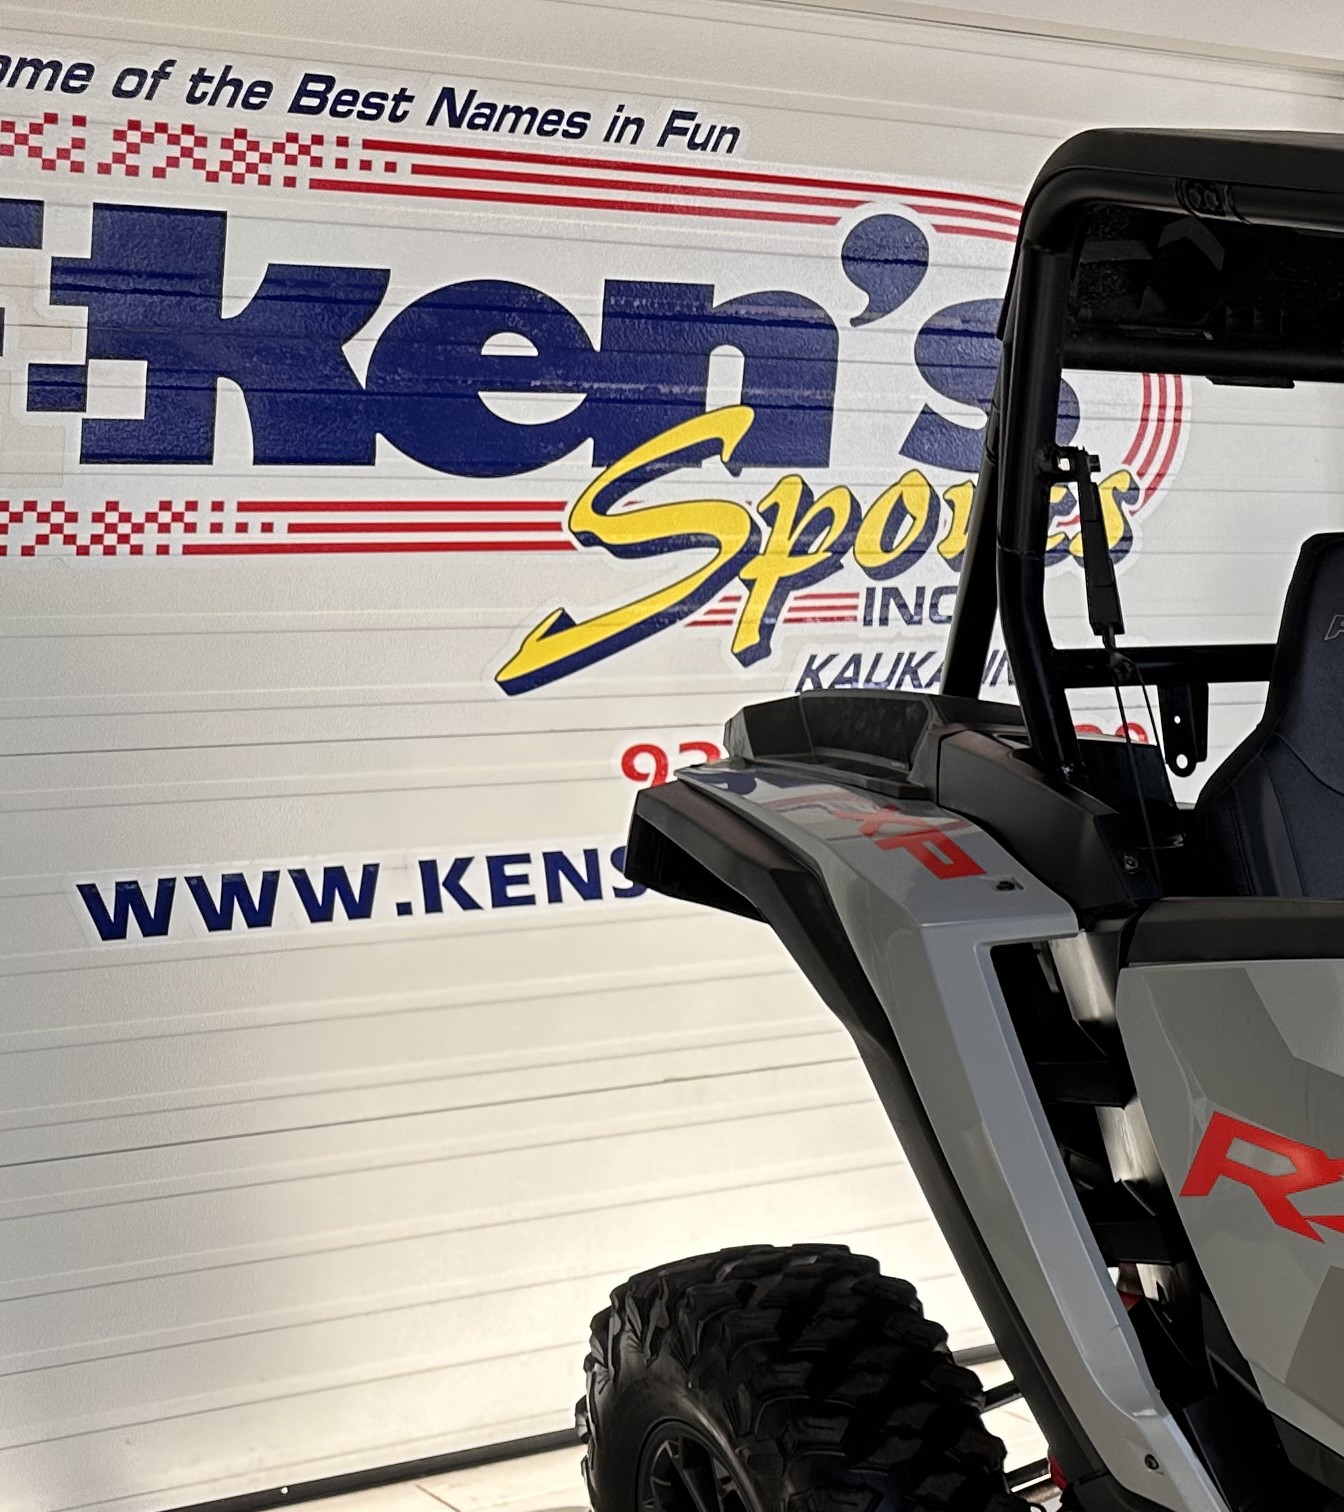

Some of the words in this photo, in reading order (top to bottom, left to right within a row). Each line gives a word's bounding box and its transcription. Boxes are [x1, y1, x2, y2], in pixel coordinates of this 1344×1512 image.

[111, 59, 177, 101] of
[185, 65, 273, 110] the
[287, 73, 415, 124] Best
[426, 86, 592, 140] Names
[603, 104, 645, 145] in
[656, 109, 741, 154] Fun
[76, 847, 645, 941] WWW.KENS
